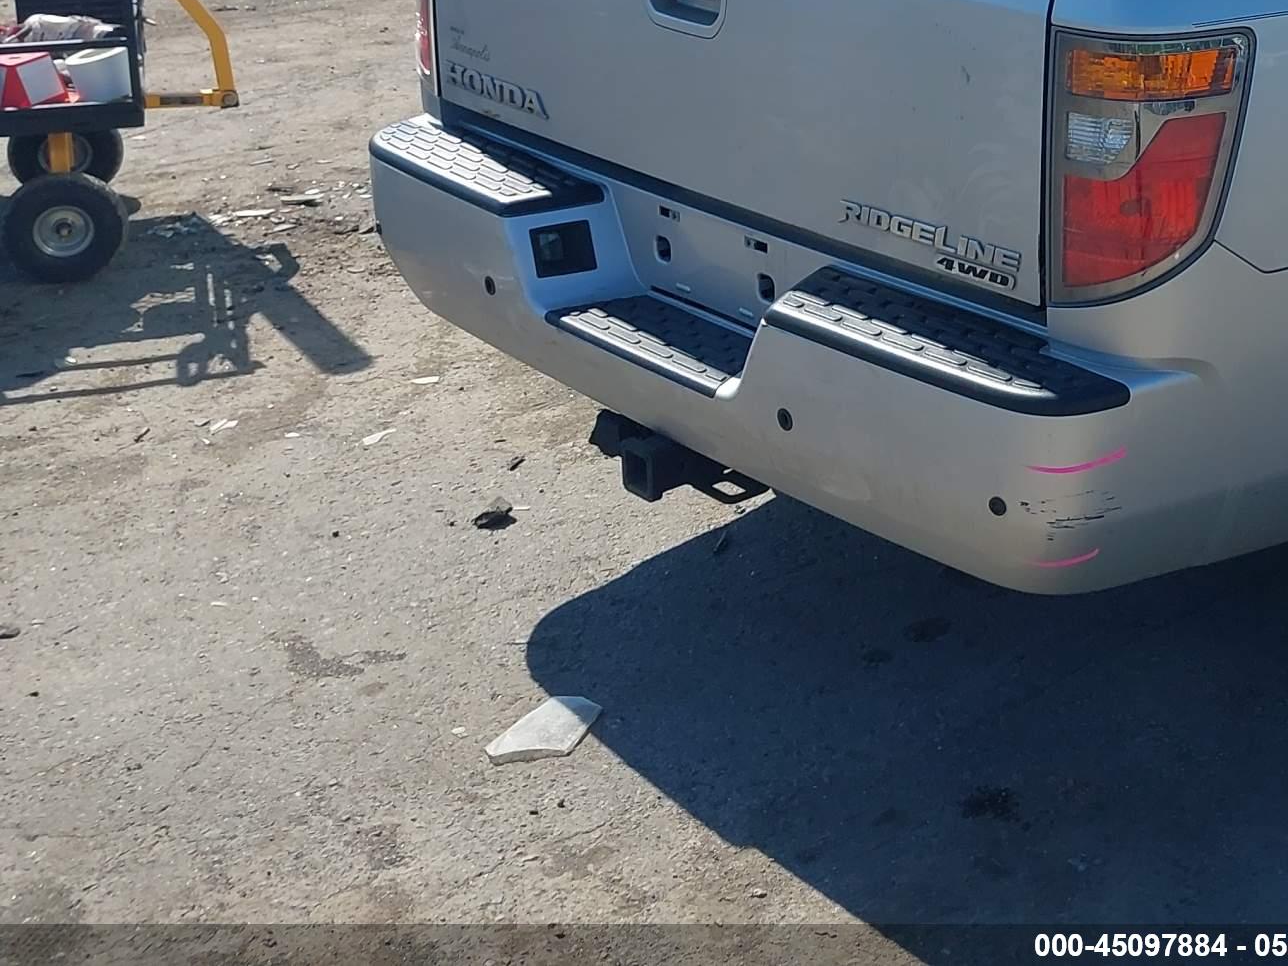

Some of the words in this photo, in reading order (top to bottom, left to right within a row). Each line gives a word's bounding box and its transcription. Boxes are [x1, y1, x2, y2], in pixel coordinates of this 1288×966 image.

[446, 61, 549, 119] HONDA
[838, 199, 1022, 272] RIDGELINE
[937, 255, 1011, 286] 4WD
